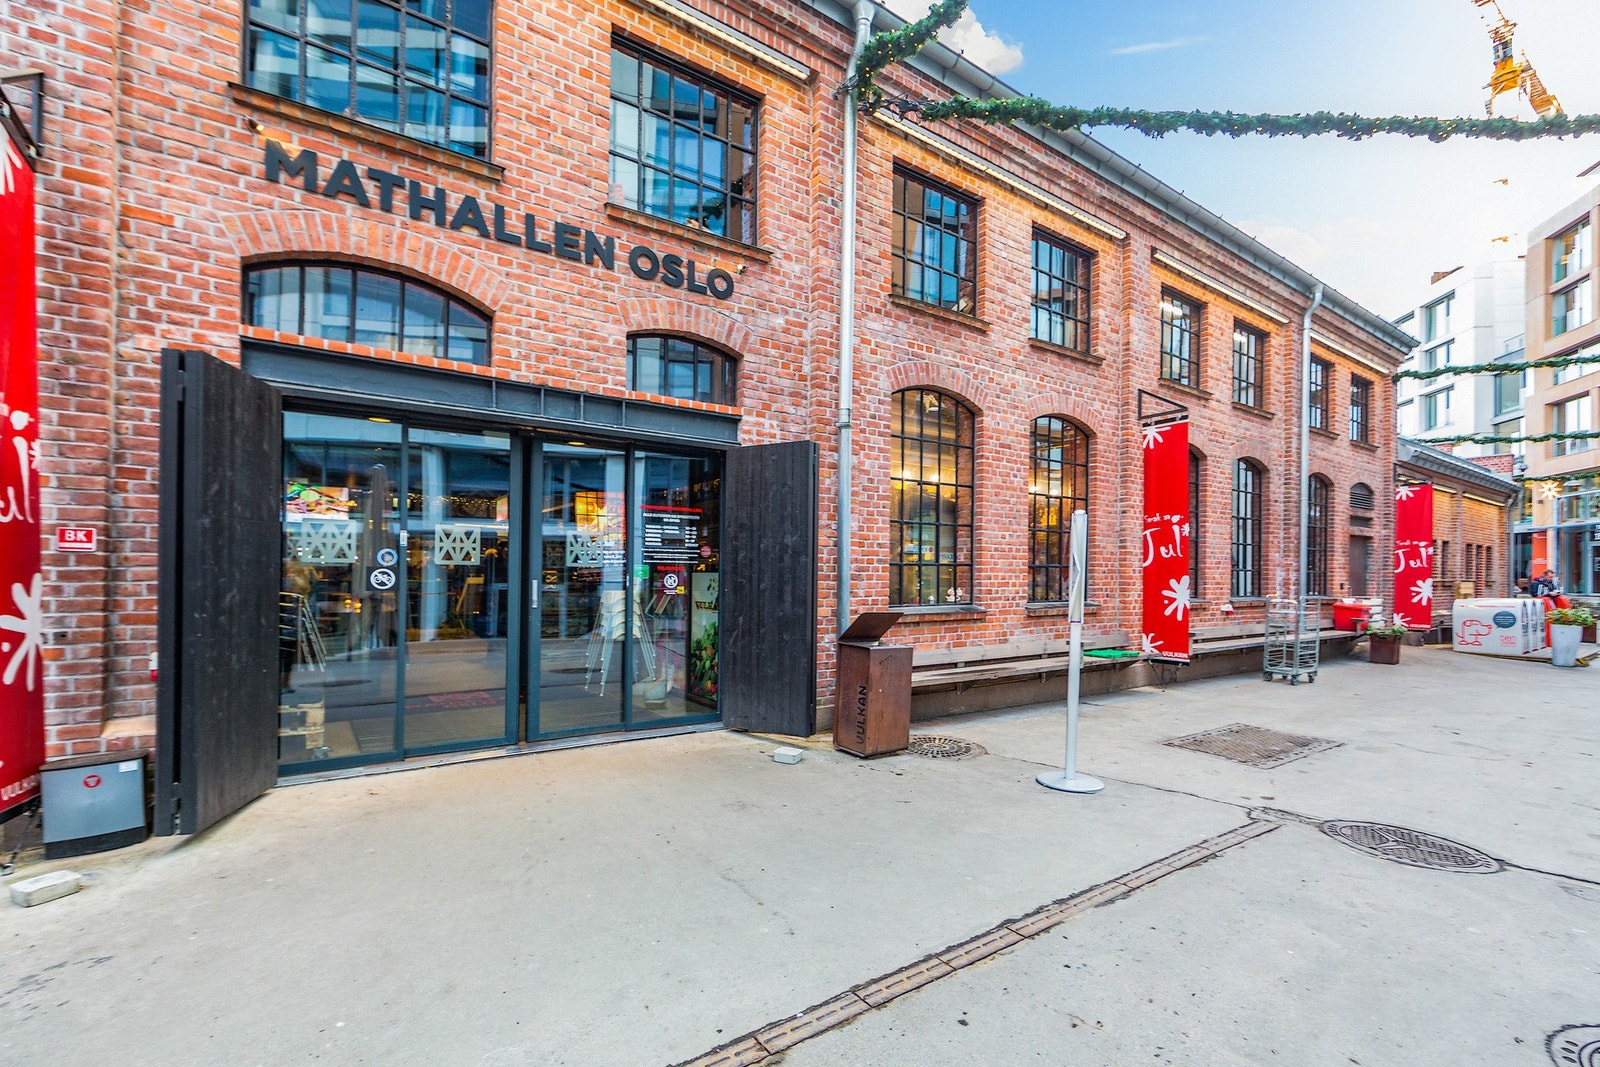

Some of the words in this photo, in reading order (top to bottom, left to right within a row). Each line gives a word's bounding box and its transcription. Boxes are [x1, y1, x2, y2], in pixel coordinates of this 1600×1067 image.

[264, 138, 614, 270] MATHALLEN
[628, 245, 735, 300] OSLO
[0, 436, 35, 523] ul
[65, 530, 88, 541] BK
[1142, 524, 1184, 567] Jul
[1394, 547, 1428, 573] Jul
[856, 685, 868, 744] VULKAN
